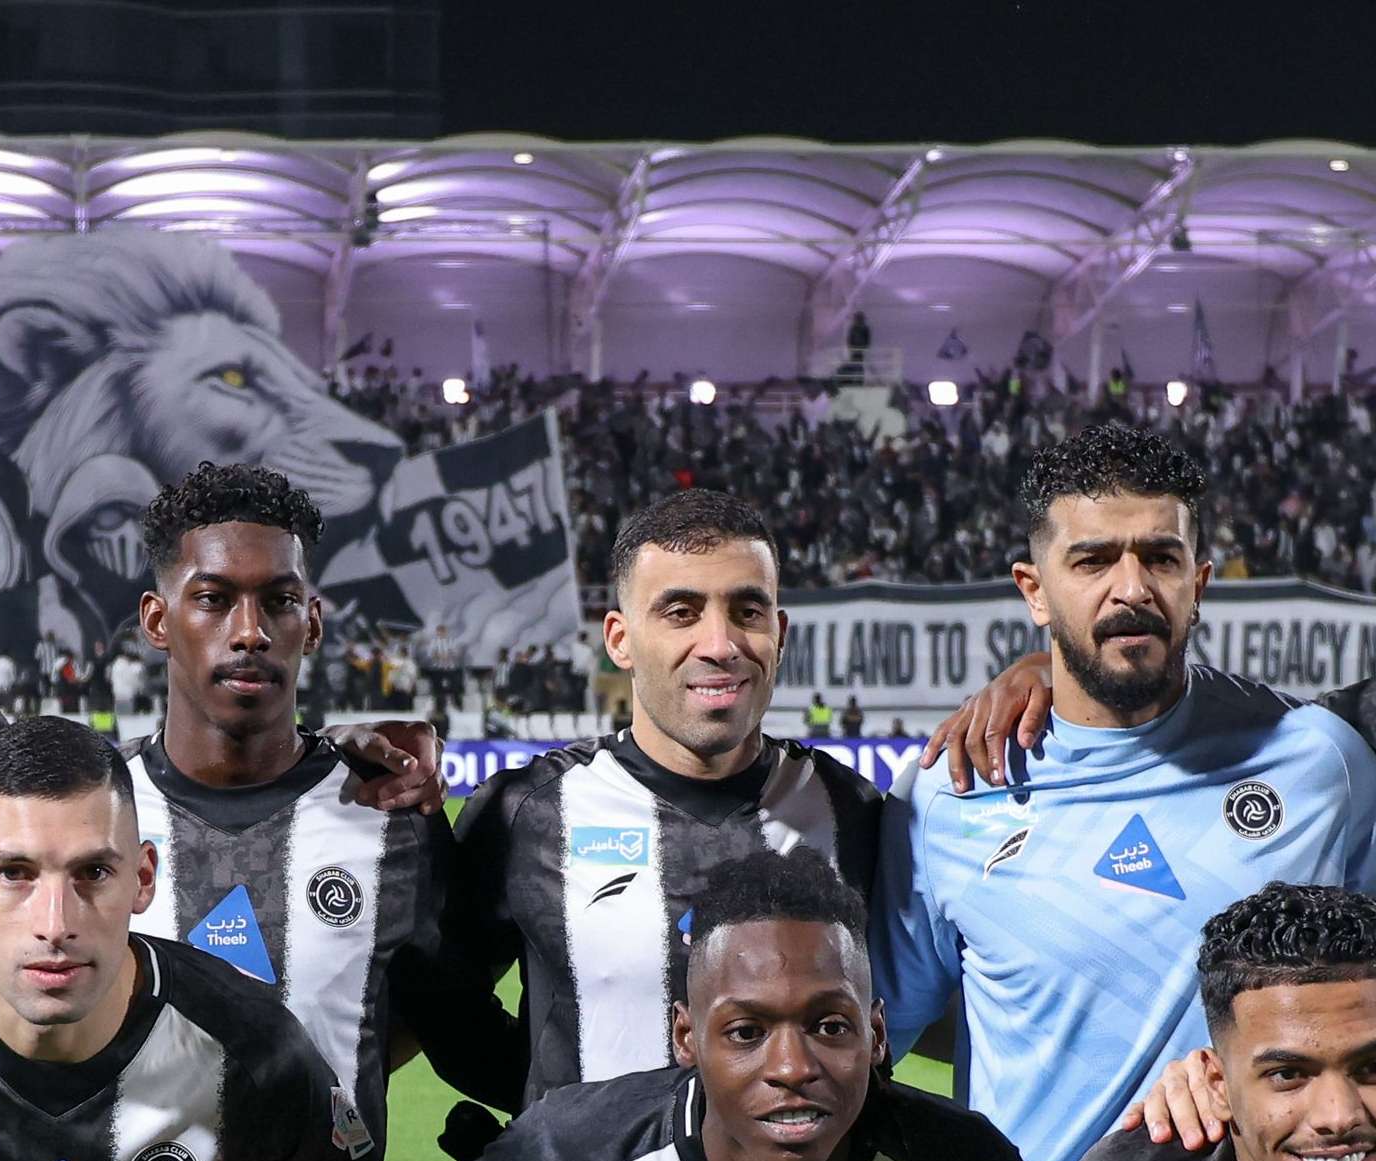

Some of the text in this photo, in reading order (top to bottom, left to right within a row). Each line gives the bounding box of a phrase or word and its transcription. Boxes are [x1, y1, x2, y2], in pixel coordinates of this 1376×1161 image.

[410, 460, 555, 584] 1947
[827, 619, 915, 688] LAND
[926, 621, 968, 688] TO
[1229, 785, 1270, 801] SHABAB CLUB
[1109, 841, 1150, 861] ذيب
[1112, 858, 1153, 876] Theeb
[315, 871, 355, 886] SHABAB CLUB
[206, 915, 247, 933] ذيب
[206, 932, 247, 946] Theeb
[170, 1145, 189, 1160] CLUB
